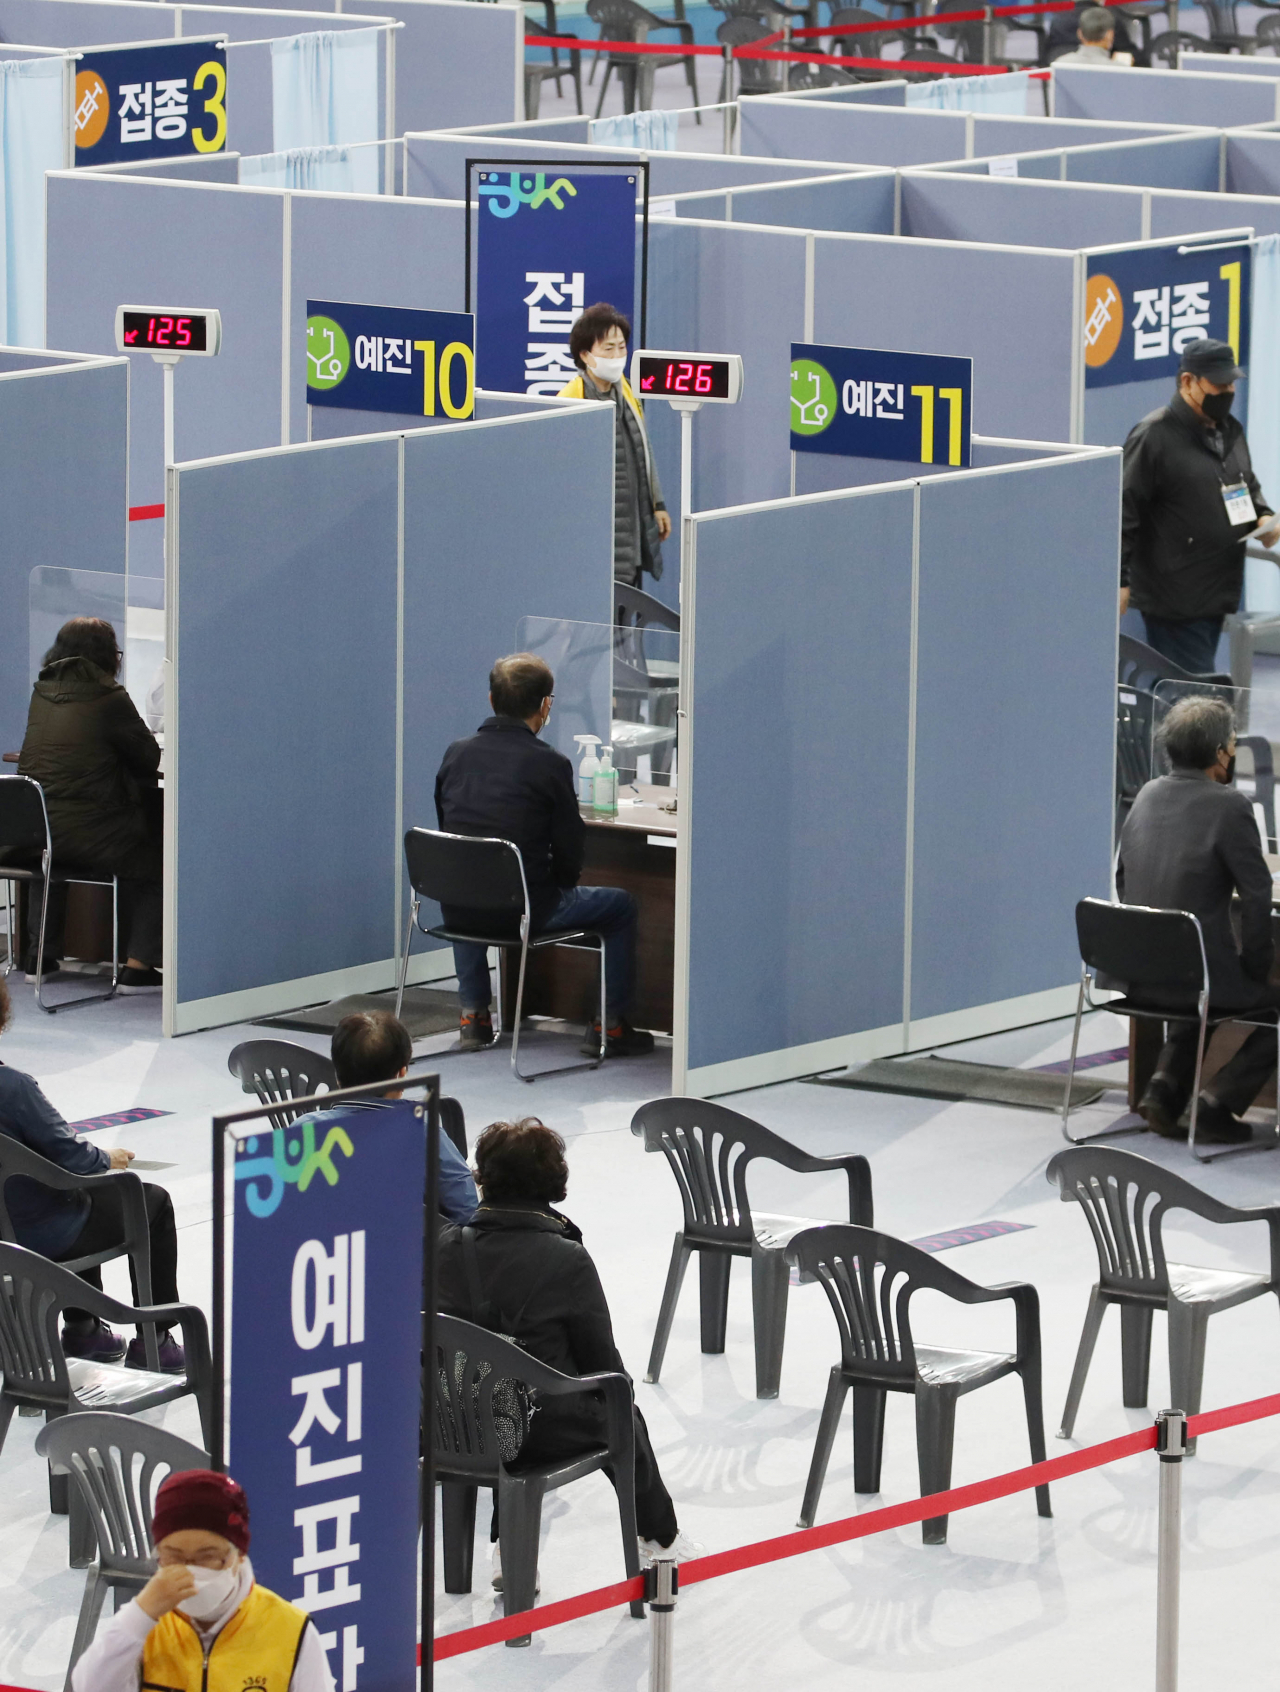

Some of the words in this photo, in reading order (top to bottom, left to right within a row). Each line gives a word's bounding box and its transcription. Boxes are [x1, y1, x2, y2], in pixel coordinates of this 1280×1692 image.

[118, 78, 188, 143] 접종
[191, 60, 227, 153] 3
[146, 317, 193, 346] 125
[1131, 281, 1210, 361] 접종
[1219, 261, 1241, 366] 1
[354, 335, 412, 374] 예진
[413, 340, 475, 419] 10
[664, 363, 714, 393] 126
[842, 379, 904, 420] 예진
[911, 385, 963, 467] 11
